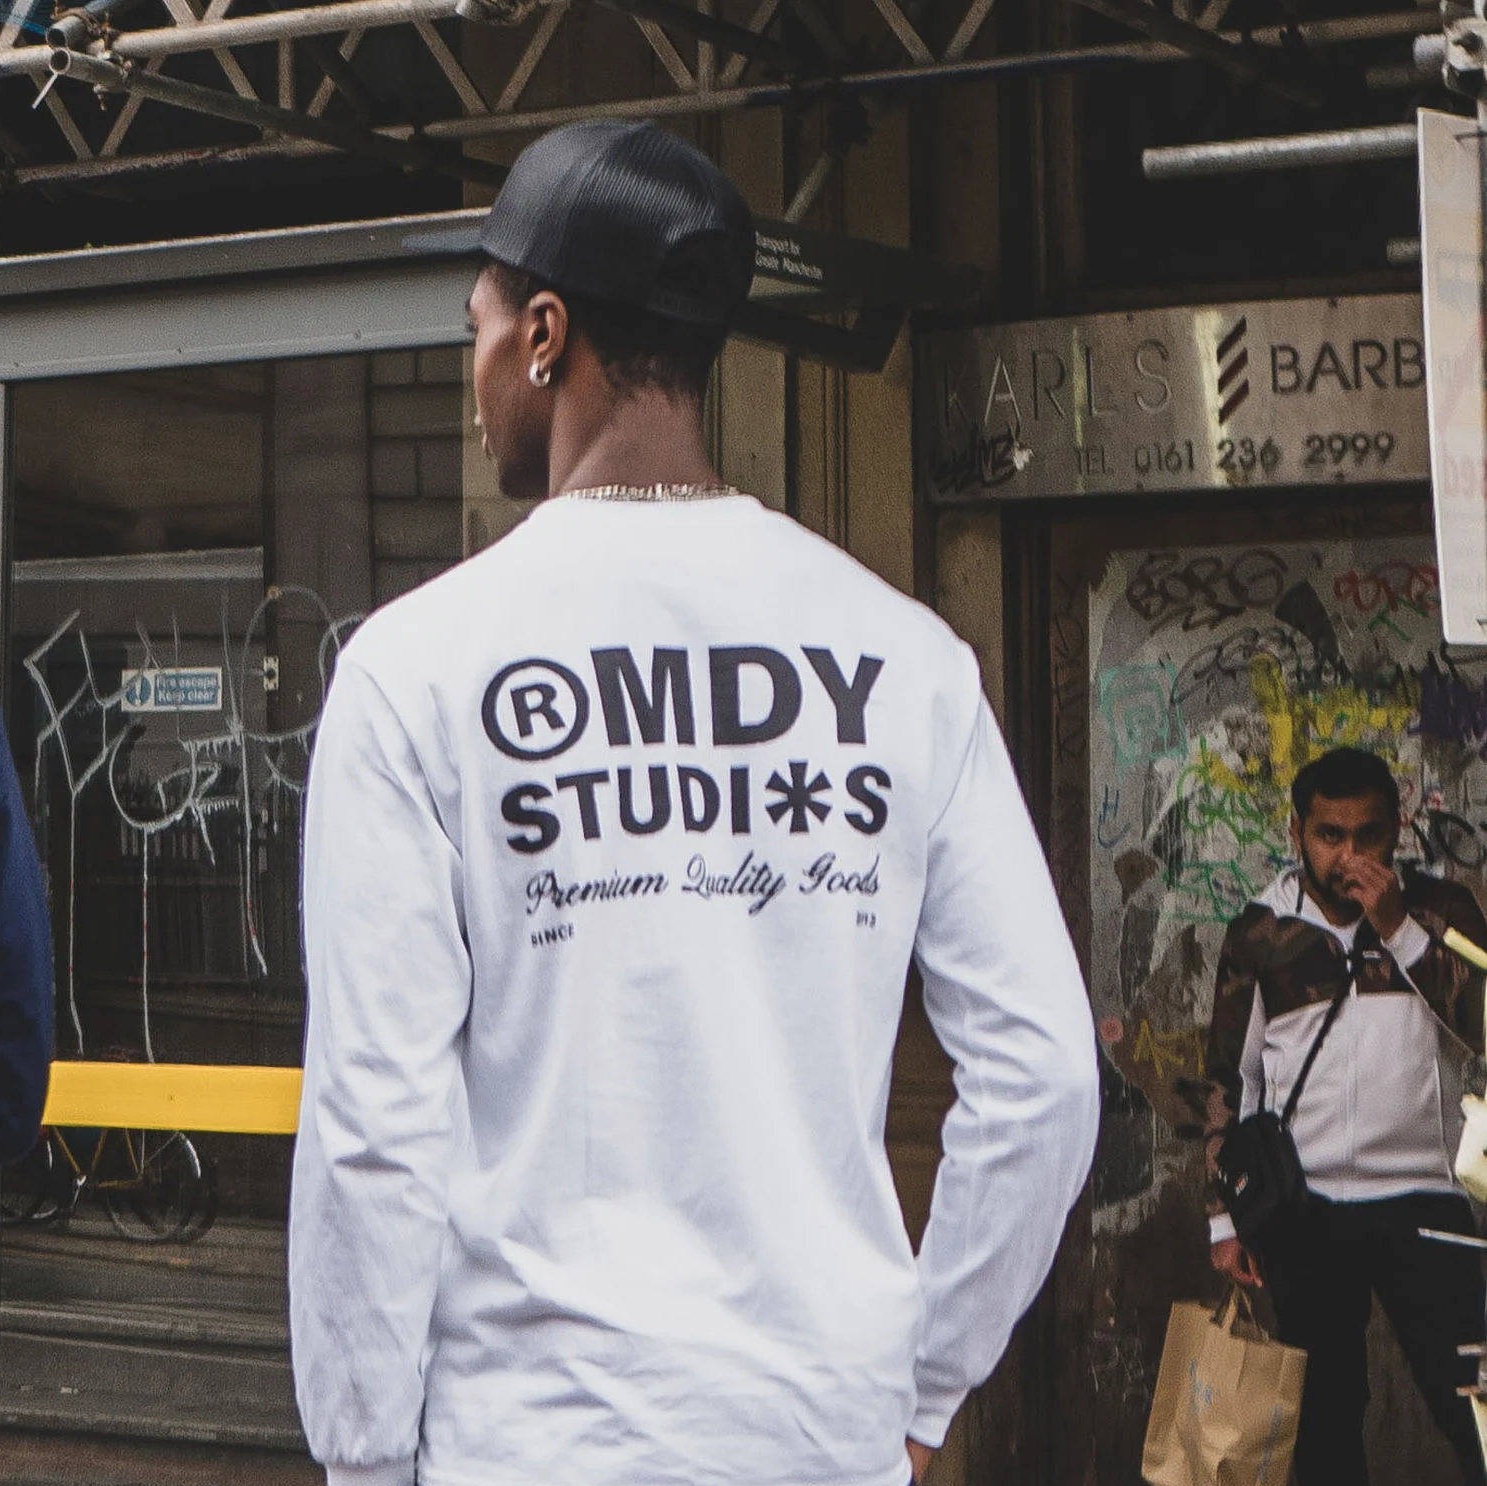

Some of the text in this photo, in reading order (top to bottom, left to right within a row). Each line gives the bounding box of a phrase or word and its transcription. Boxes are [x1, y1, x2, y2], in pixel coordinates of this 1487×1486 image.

[1270, 337, 1426, 394] BARB
[1134, 440, 1194, 476] 0161
[1218, 436, 1282, 474] 236
[1304, 431, 1395, 468] 2999
[157, 688, 215, 703] Keep clear
[526, 850, 881, 916] Premium Quality Goods
